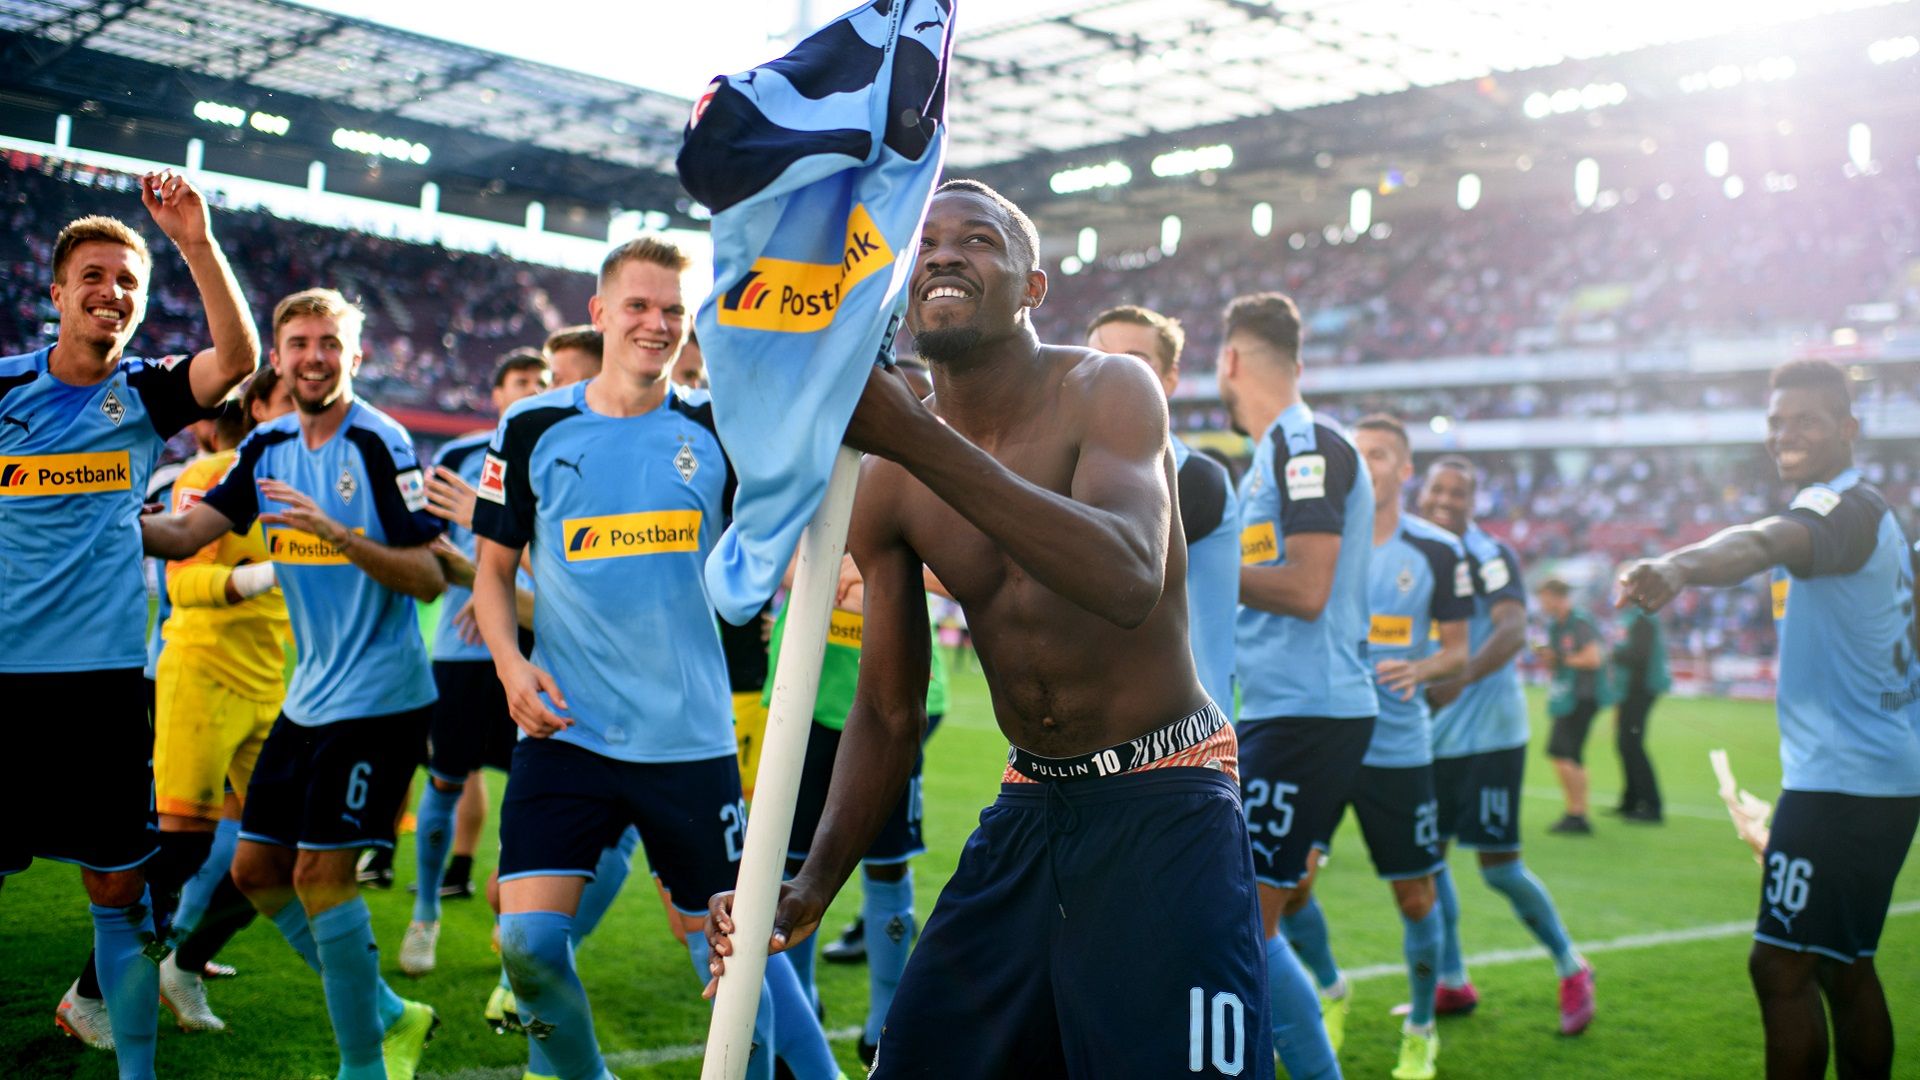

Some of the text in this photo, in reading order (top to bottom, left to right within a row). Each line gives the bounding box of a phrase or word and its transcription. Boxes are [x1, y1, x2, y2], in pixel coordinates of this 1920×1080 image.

[38, 462, 127, 486] Postbank
[610, 523, 696, 547] Postbank
[1031, 749, 1121, 777] PULLIN 10
[345, 761, 372, 810] 6
[1480, 787, 1509, 826] 14
[1243, 779, 1299, 837] 25
[1766, 850, 1813, 914] 36
[1189, 986, 1245, 1077] 10
